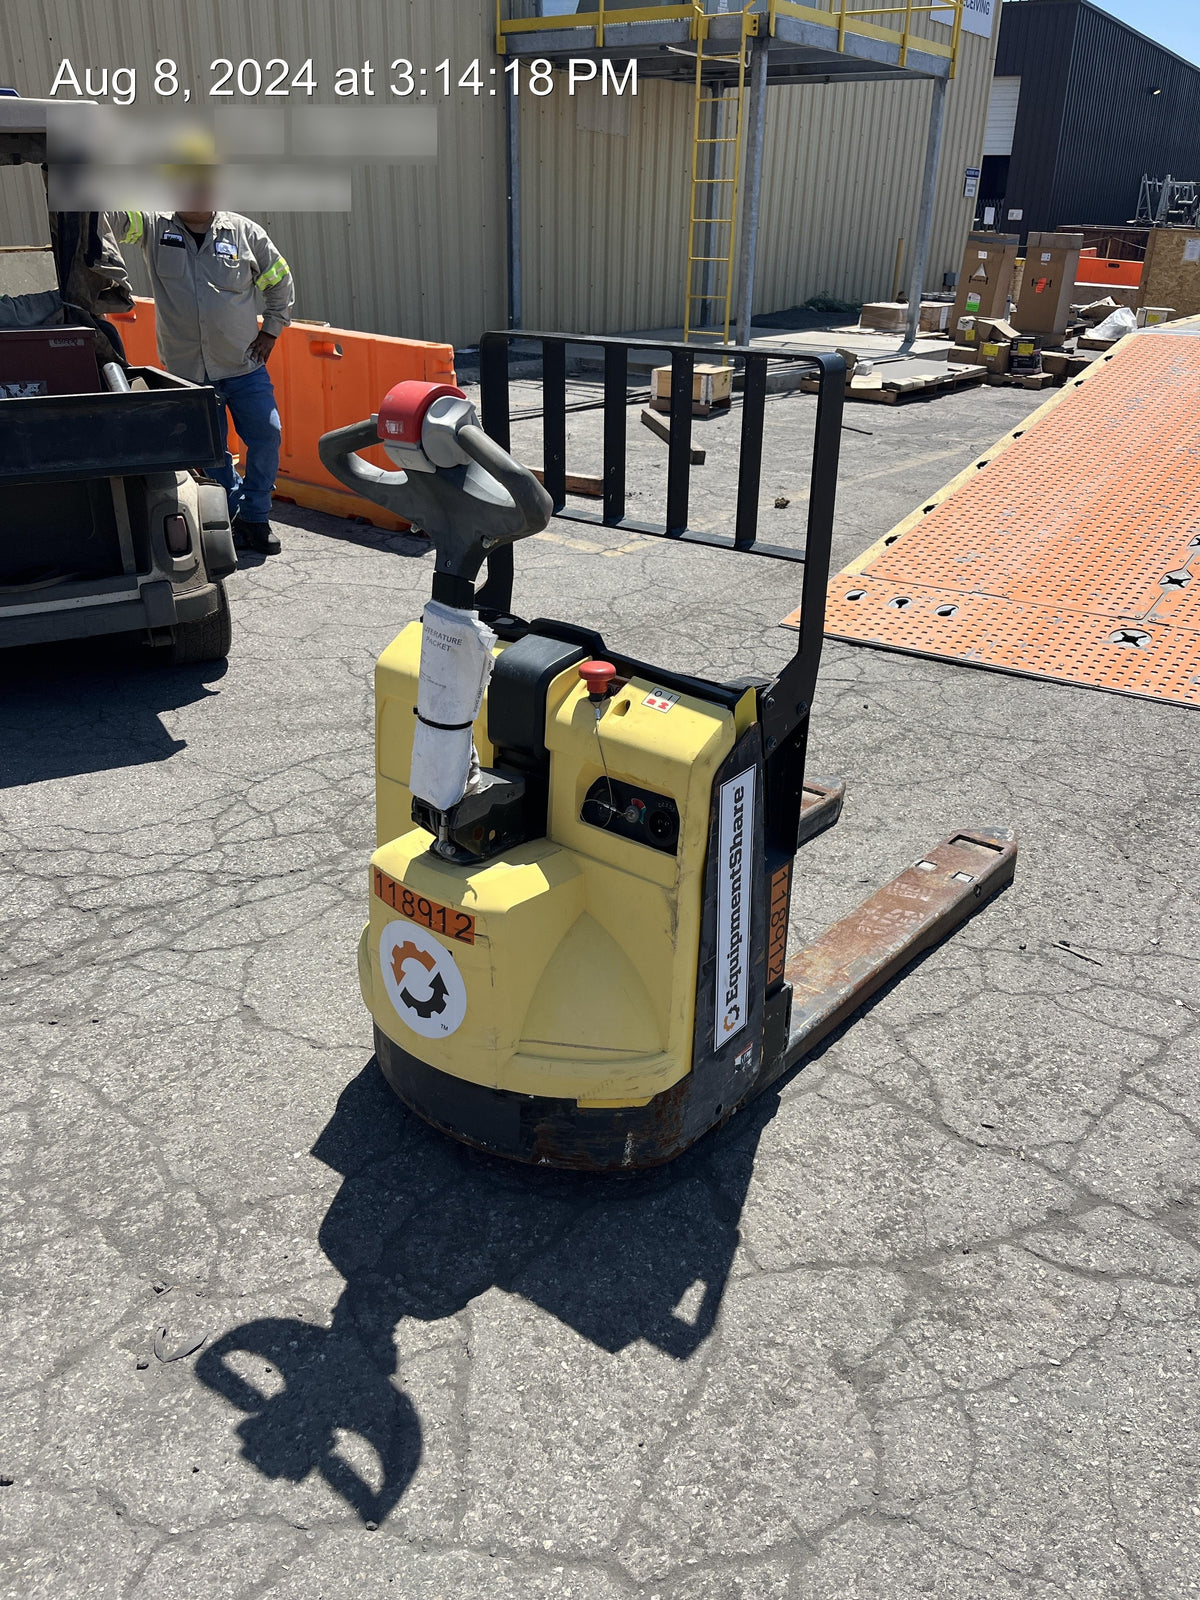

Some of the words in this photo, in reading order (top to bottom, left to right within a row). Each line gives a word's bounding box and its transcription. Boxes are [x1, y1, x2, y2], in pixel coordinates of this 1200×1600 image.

[376, 873, 473, 943] 118912
[726, 785, 744, 1006] EquipmentShare
[768, 871, 787, 982] 118912
